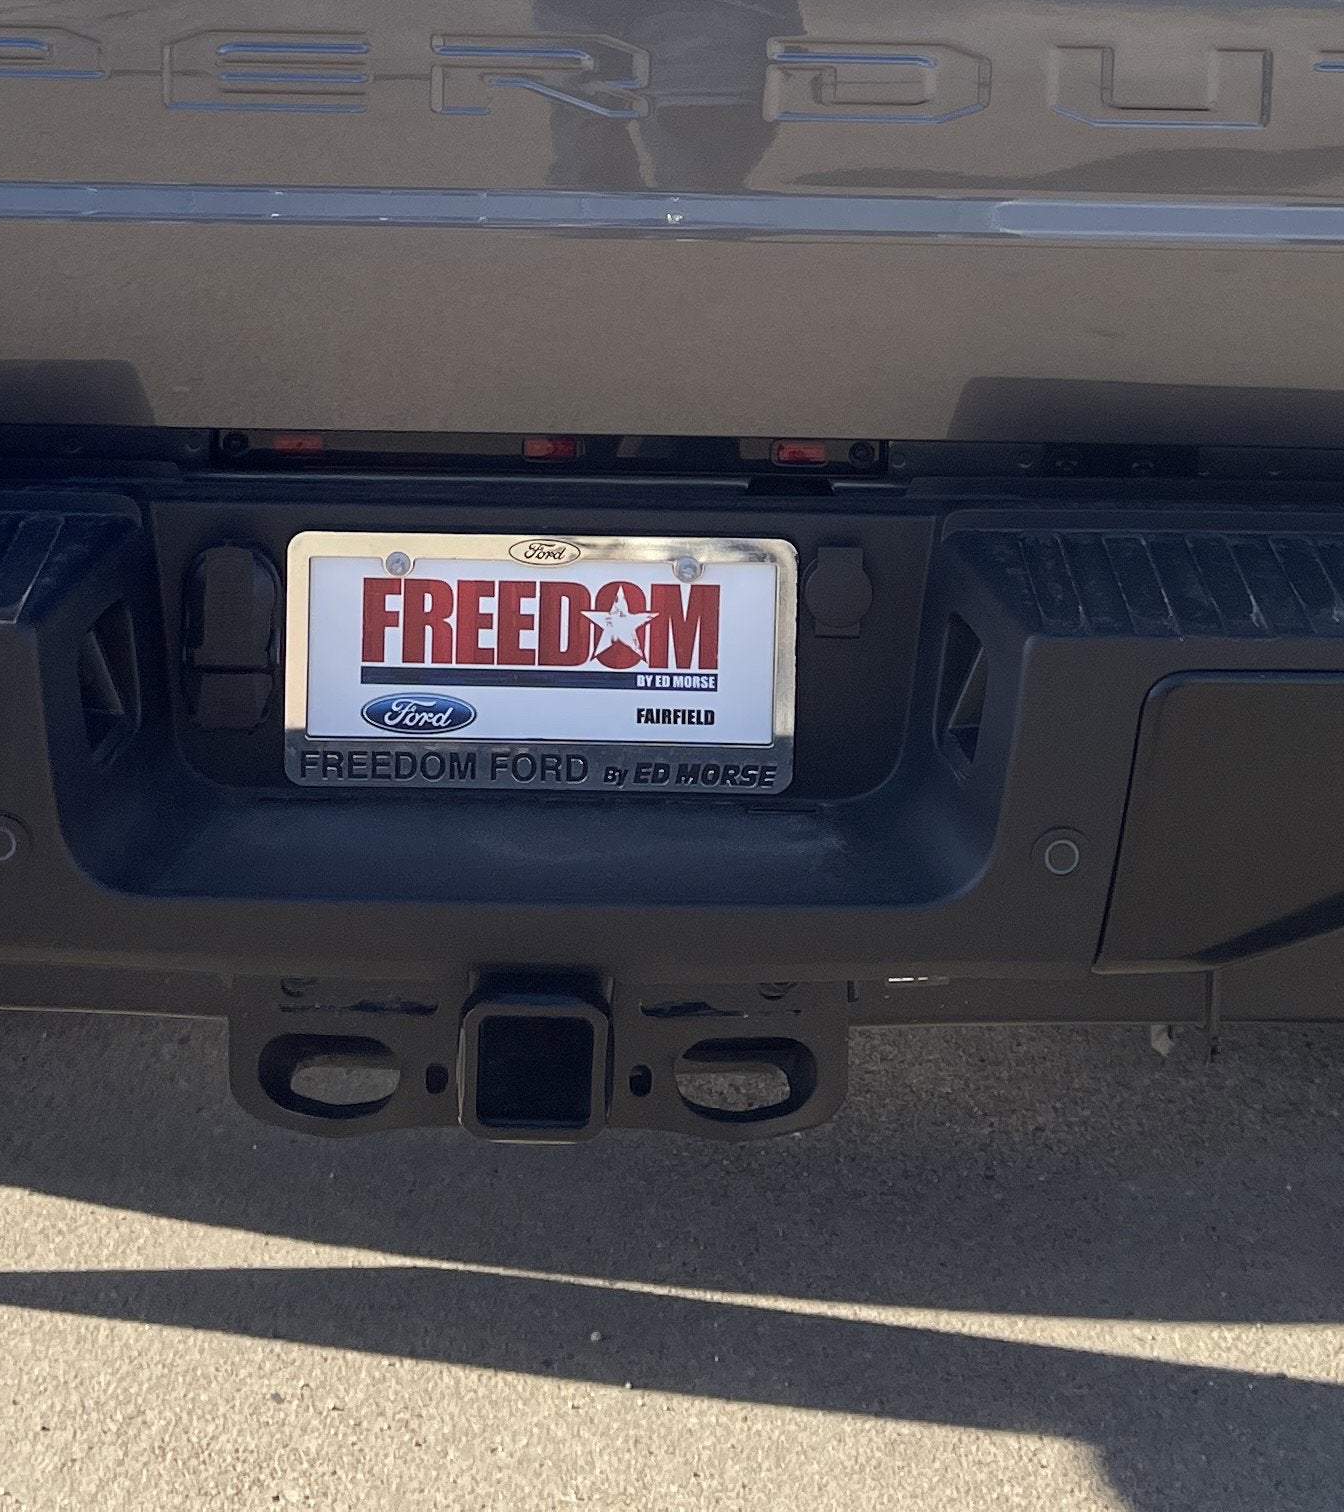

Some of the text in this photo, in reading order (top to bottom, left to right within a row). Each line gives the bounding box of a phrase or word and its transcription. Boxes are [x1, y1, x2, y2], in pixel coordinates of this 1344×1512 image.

[522, 541, 567, 561] Ford
[361, 577, 721, 671] FREEDOM
[636, 674, 716, 689] BY ED MORSE
[383, 698, 454, 727] Ford
[636, 707, 715, 726] FAIRFIELD
[299, 750, 477, 782] FREEDOM
[490, 752, 589, 784] FORD
[633, 762, 671, 785] ED
[674, 763, 778, 788] MORSE
